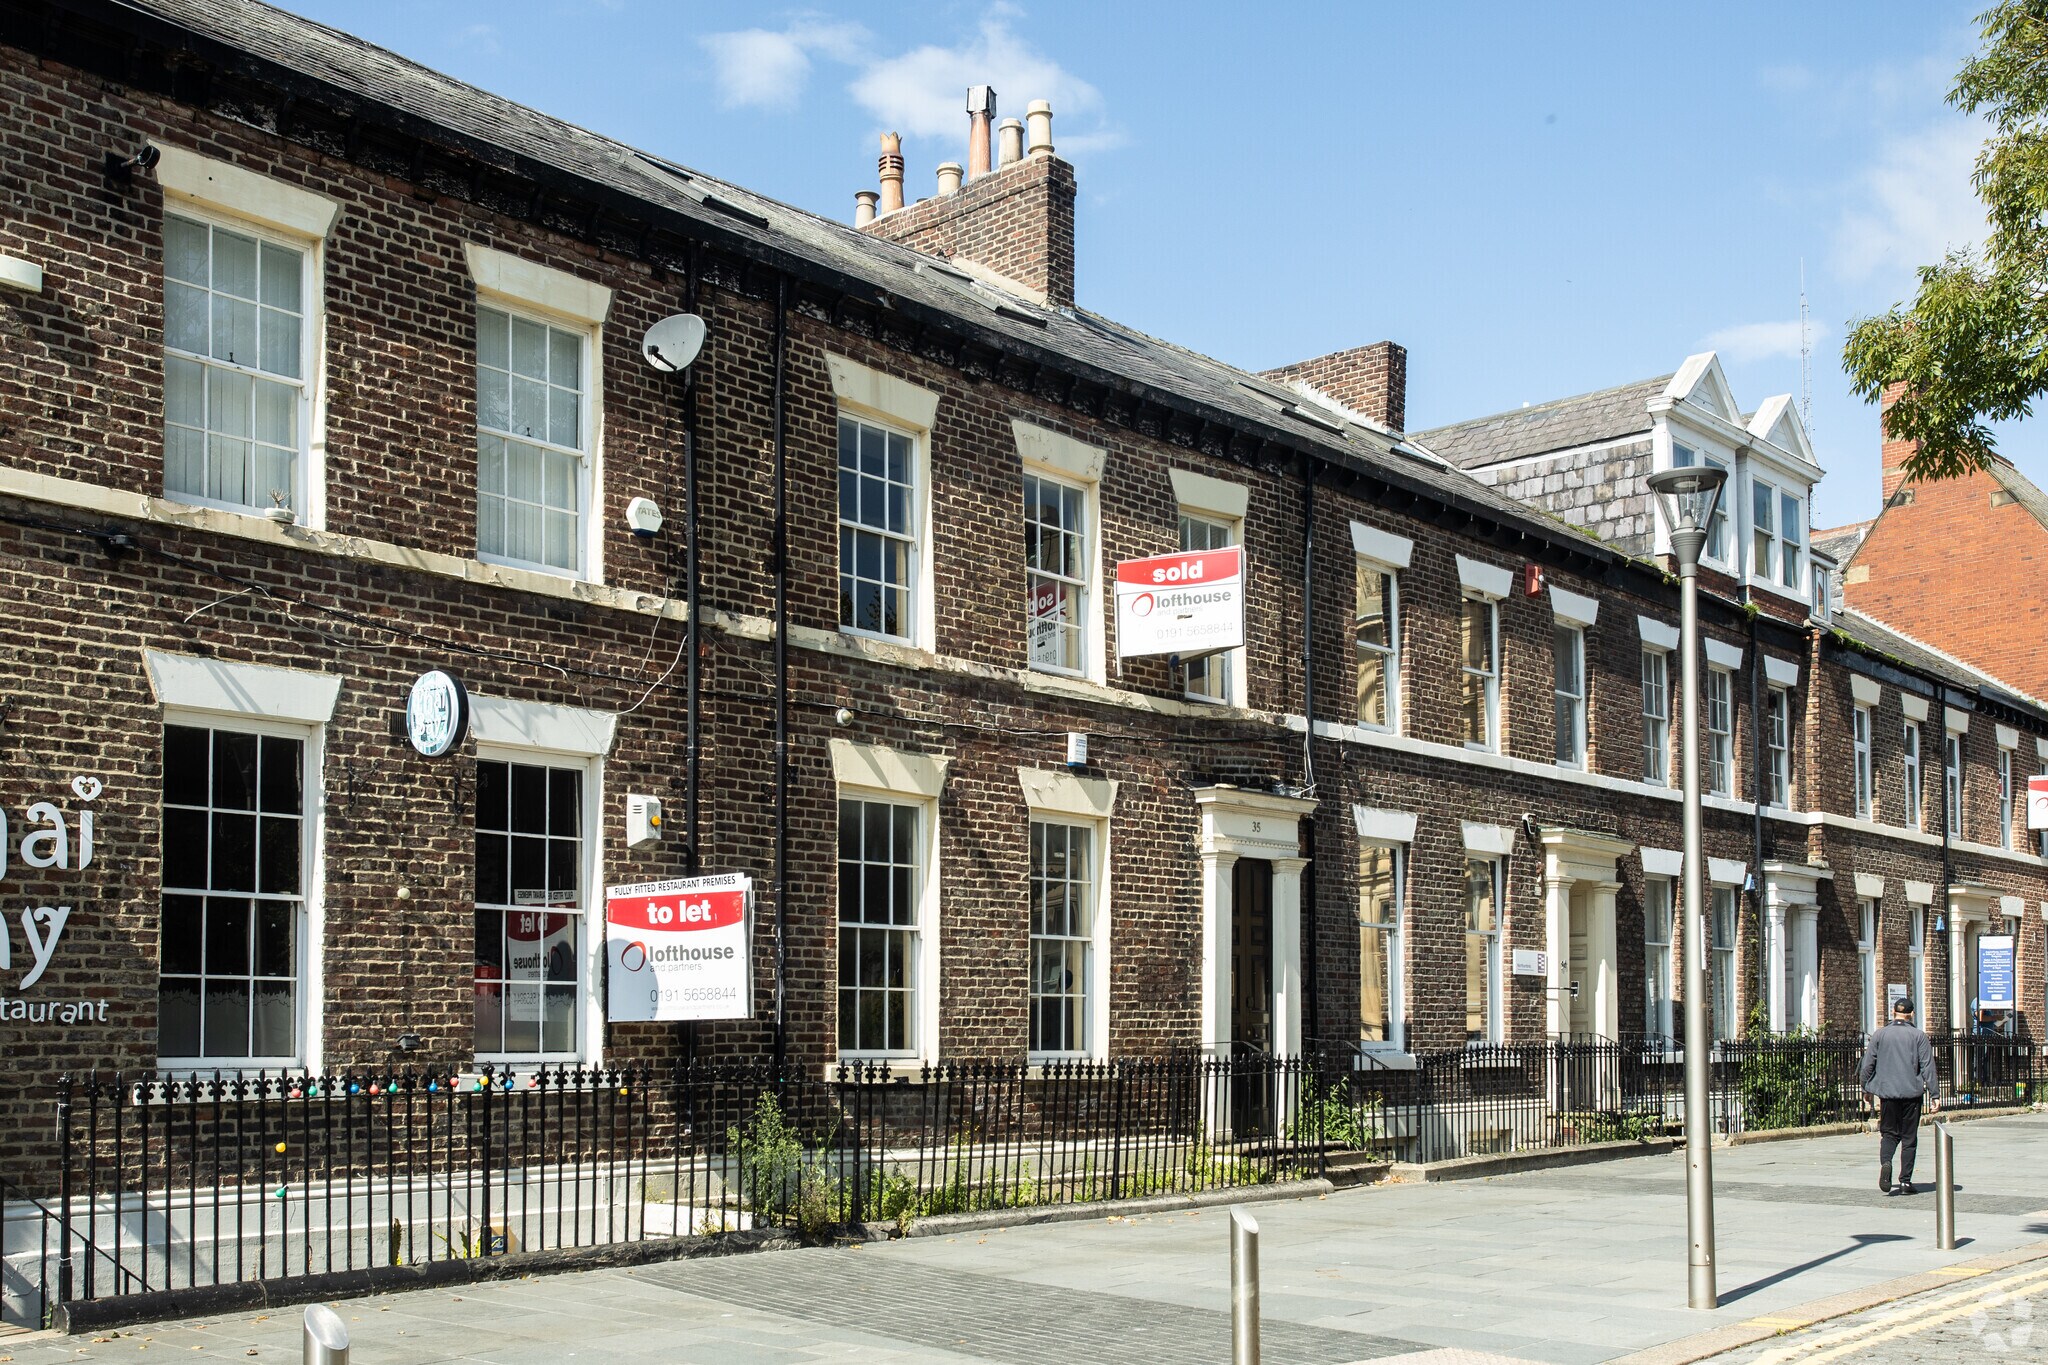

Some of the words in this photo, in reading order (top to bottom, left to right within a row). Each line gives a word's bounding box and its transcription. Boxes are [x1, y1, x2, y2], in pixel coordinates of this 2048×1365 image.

[1152, 560, 1203, 583] sold
[1156, 591, 1232, 608] lofthouse
[1157, 608, 1171, 616] and
[1173, 606, 1203, 616] partners
[1157, 627, 1182, 640] 0191
[1187, 622, 1233, 637] 5658844
[1251, 820, 1261, 833] 35
[614, 886, 633, 897] FULLY
[634, 883, 656, 895] FITTED
[658, 879, 700, 892] RESTAURANT
[702, 875, 736, 888] PREMISES
[646, 902, 673, 924] to
[679, 899, 712, 923] let
[649, 944, 735, 963] lofthouse
[650, 963, 666, 973] and
[668, 962, 703, 973] partners
[650, 989, 679, 1003] 0191
[684, 987, 737, 1002] 5658844
